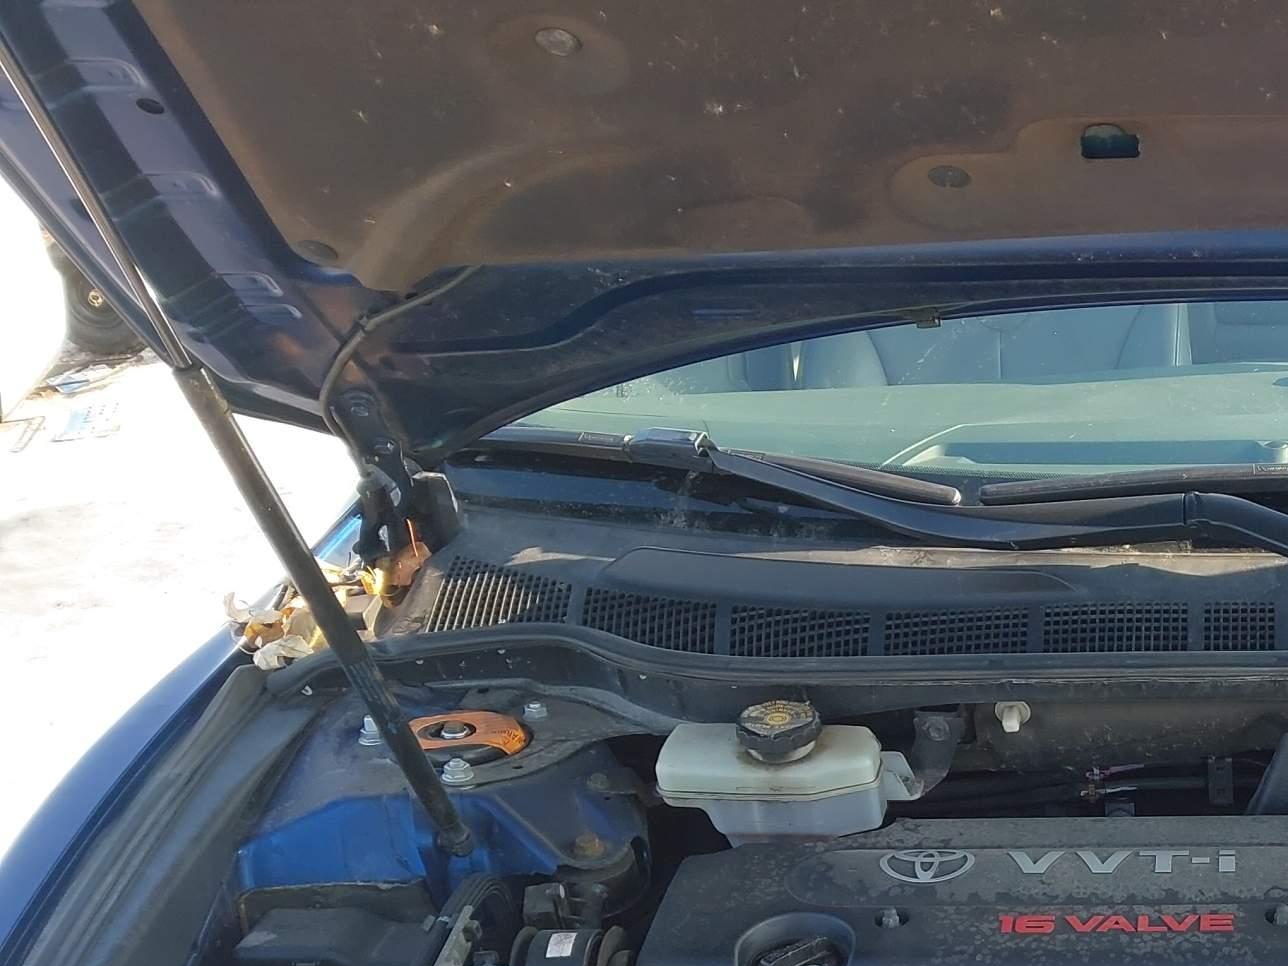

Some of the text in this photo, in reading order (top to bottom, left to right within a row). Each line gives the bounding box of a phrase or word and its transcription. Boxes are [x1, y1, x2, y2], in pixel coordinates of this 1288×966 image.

[1007, 850, 1237, 874] VVT-i
[998, 914, 1235, 933] 16 VALVE
